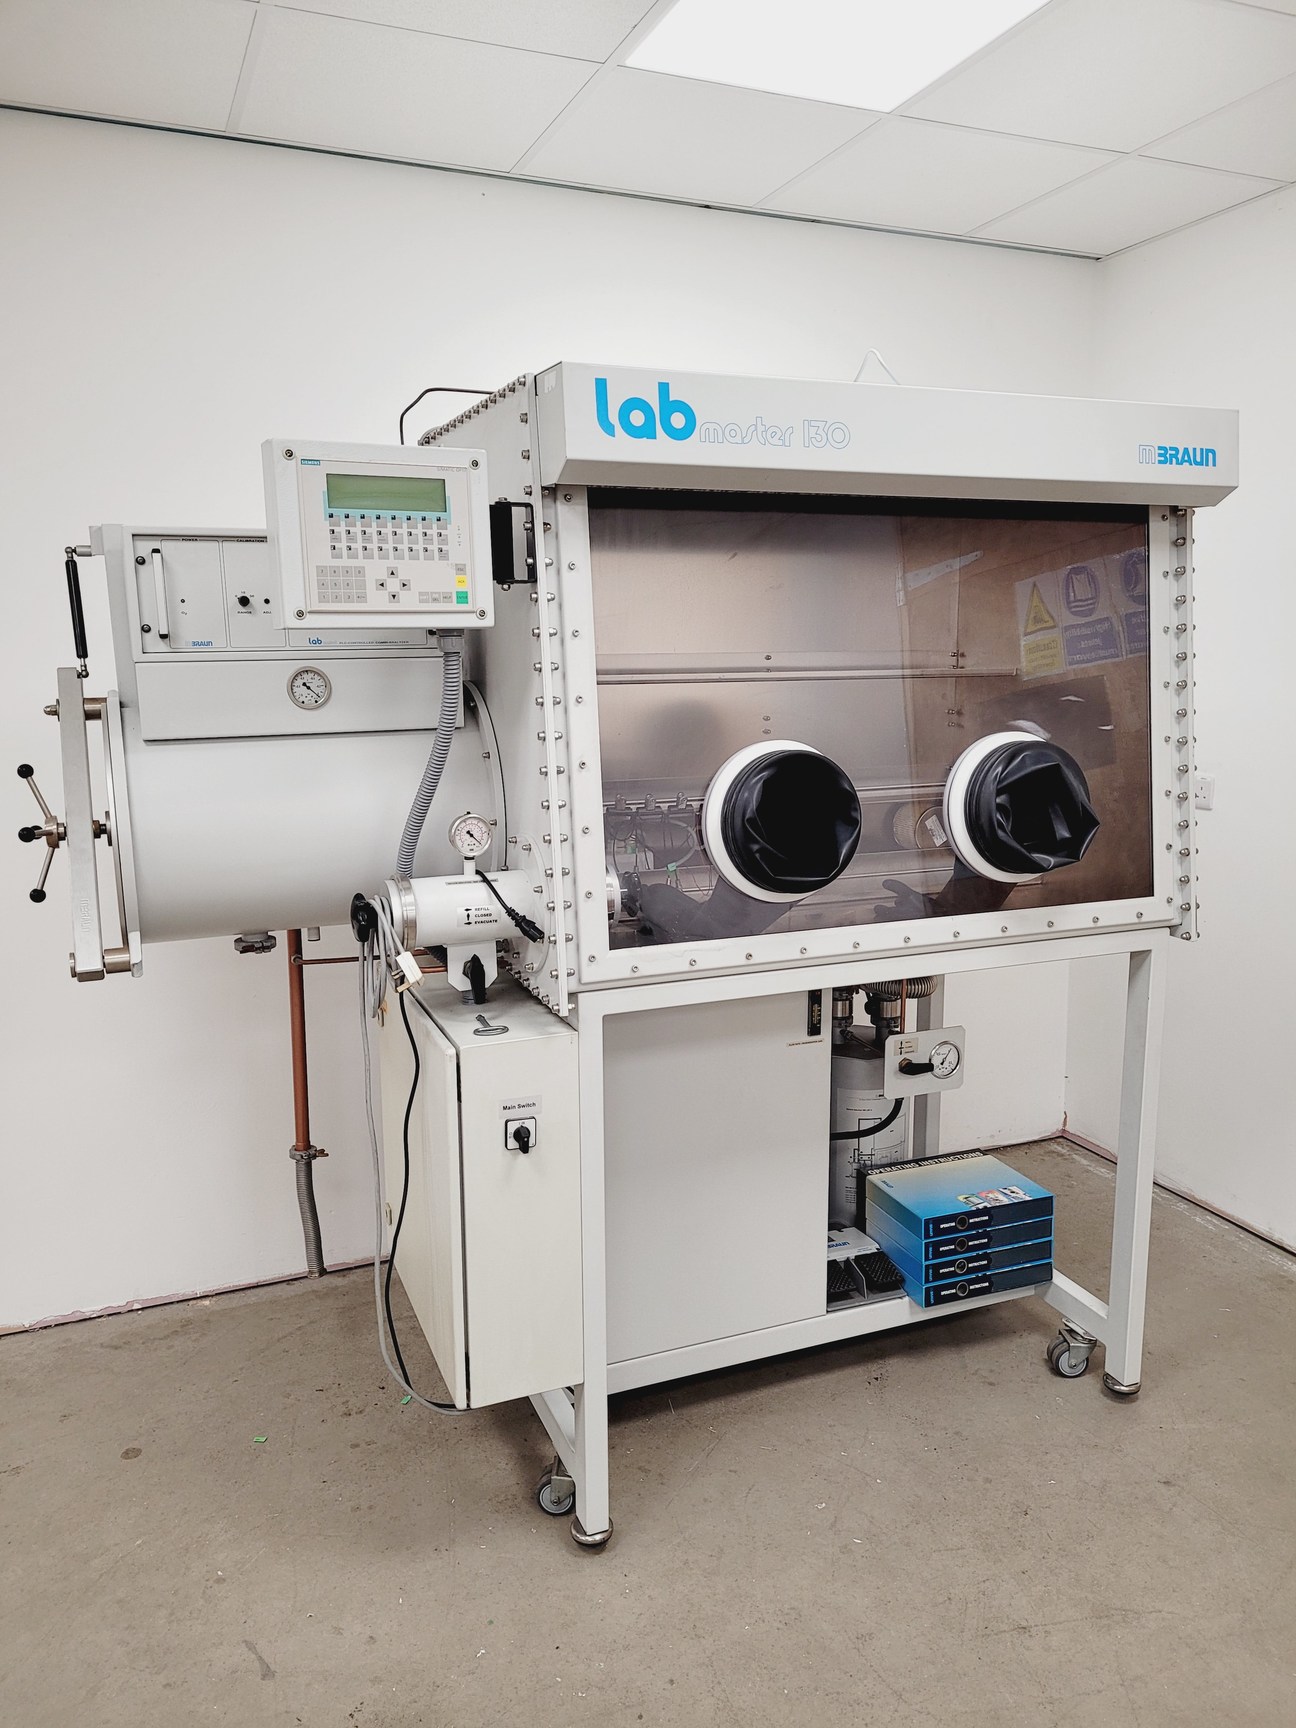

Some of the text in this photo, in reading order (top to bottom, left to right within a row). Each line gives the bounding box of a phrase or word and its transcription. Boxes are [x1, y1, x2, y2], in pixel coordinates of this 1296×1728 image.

[802, 419, 851, 450] 130
[517, 1101, 537, 1109] Switch
[867, 1151, 984, 1175] OPERATING INSTRUCTIONS
[969, 1215, 989, 1223] INSTRUCTIONS
[968, 1238, 988, 1246] INSTRUCTIONS
[939, 1266, 955, 1274] OPERATING
[940, 1282, 989, 1296] OPERATING INSTRUCTIONS
